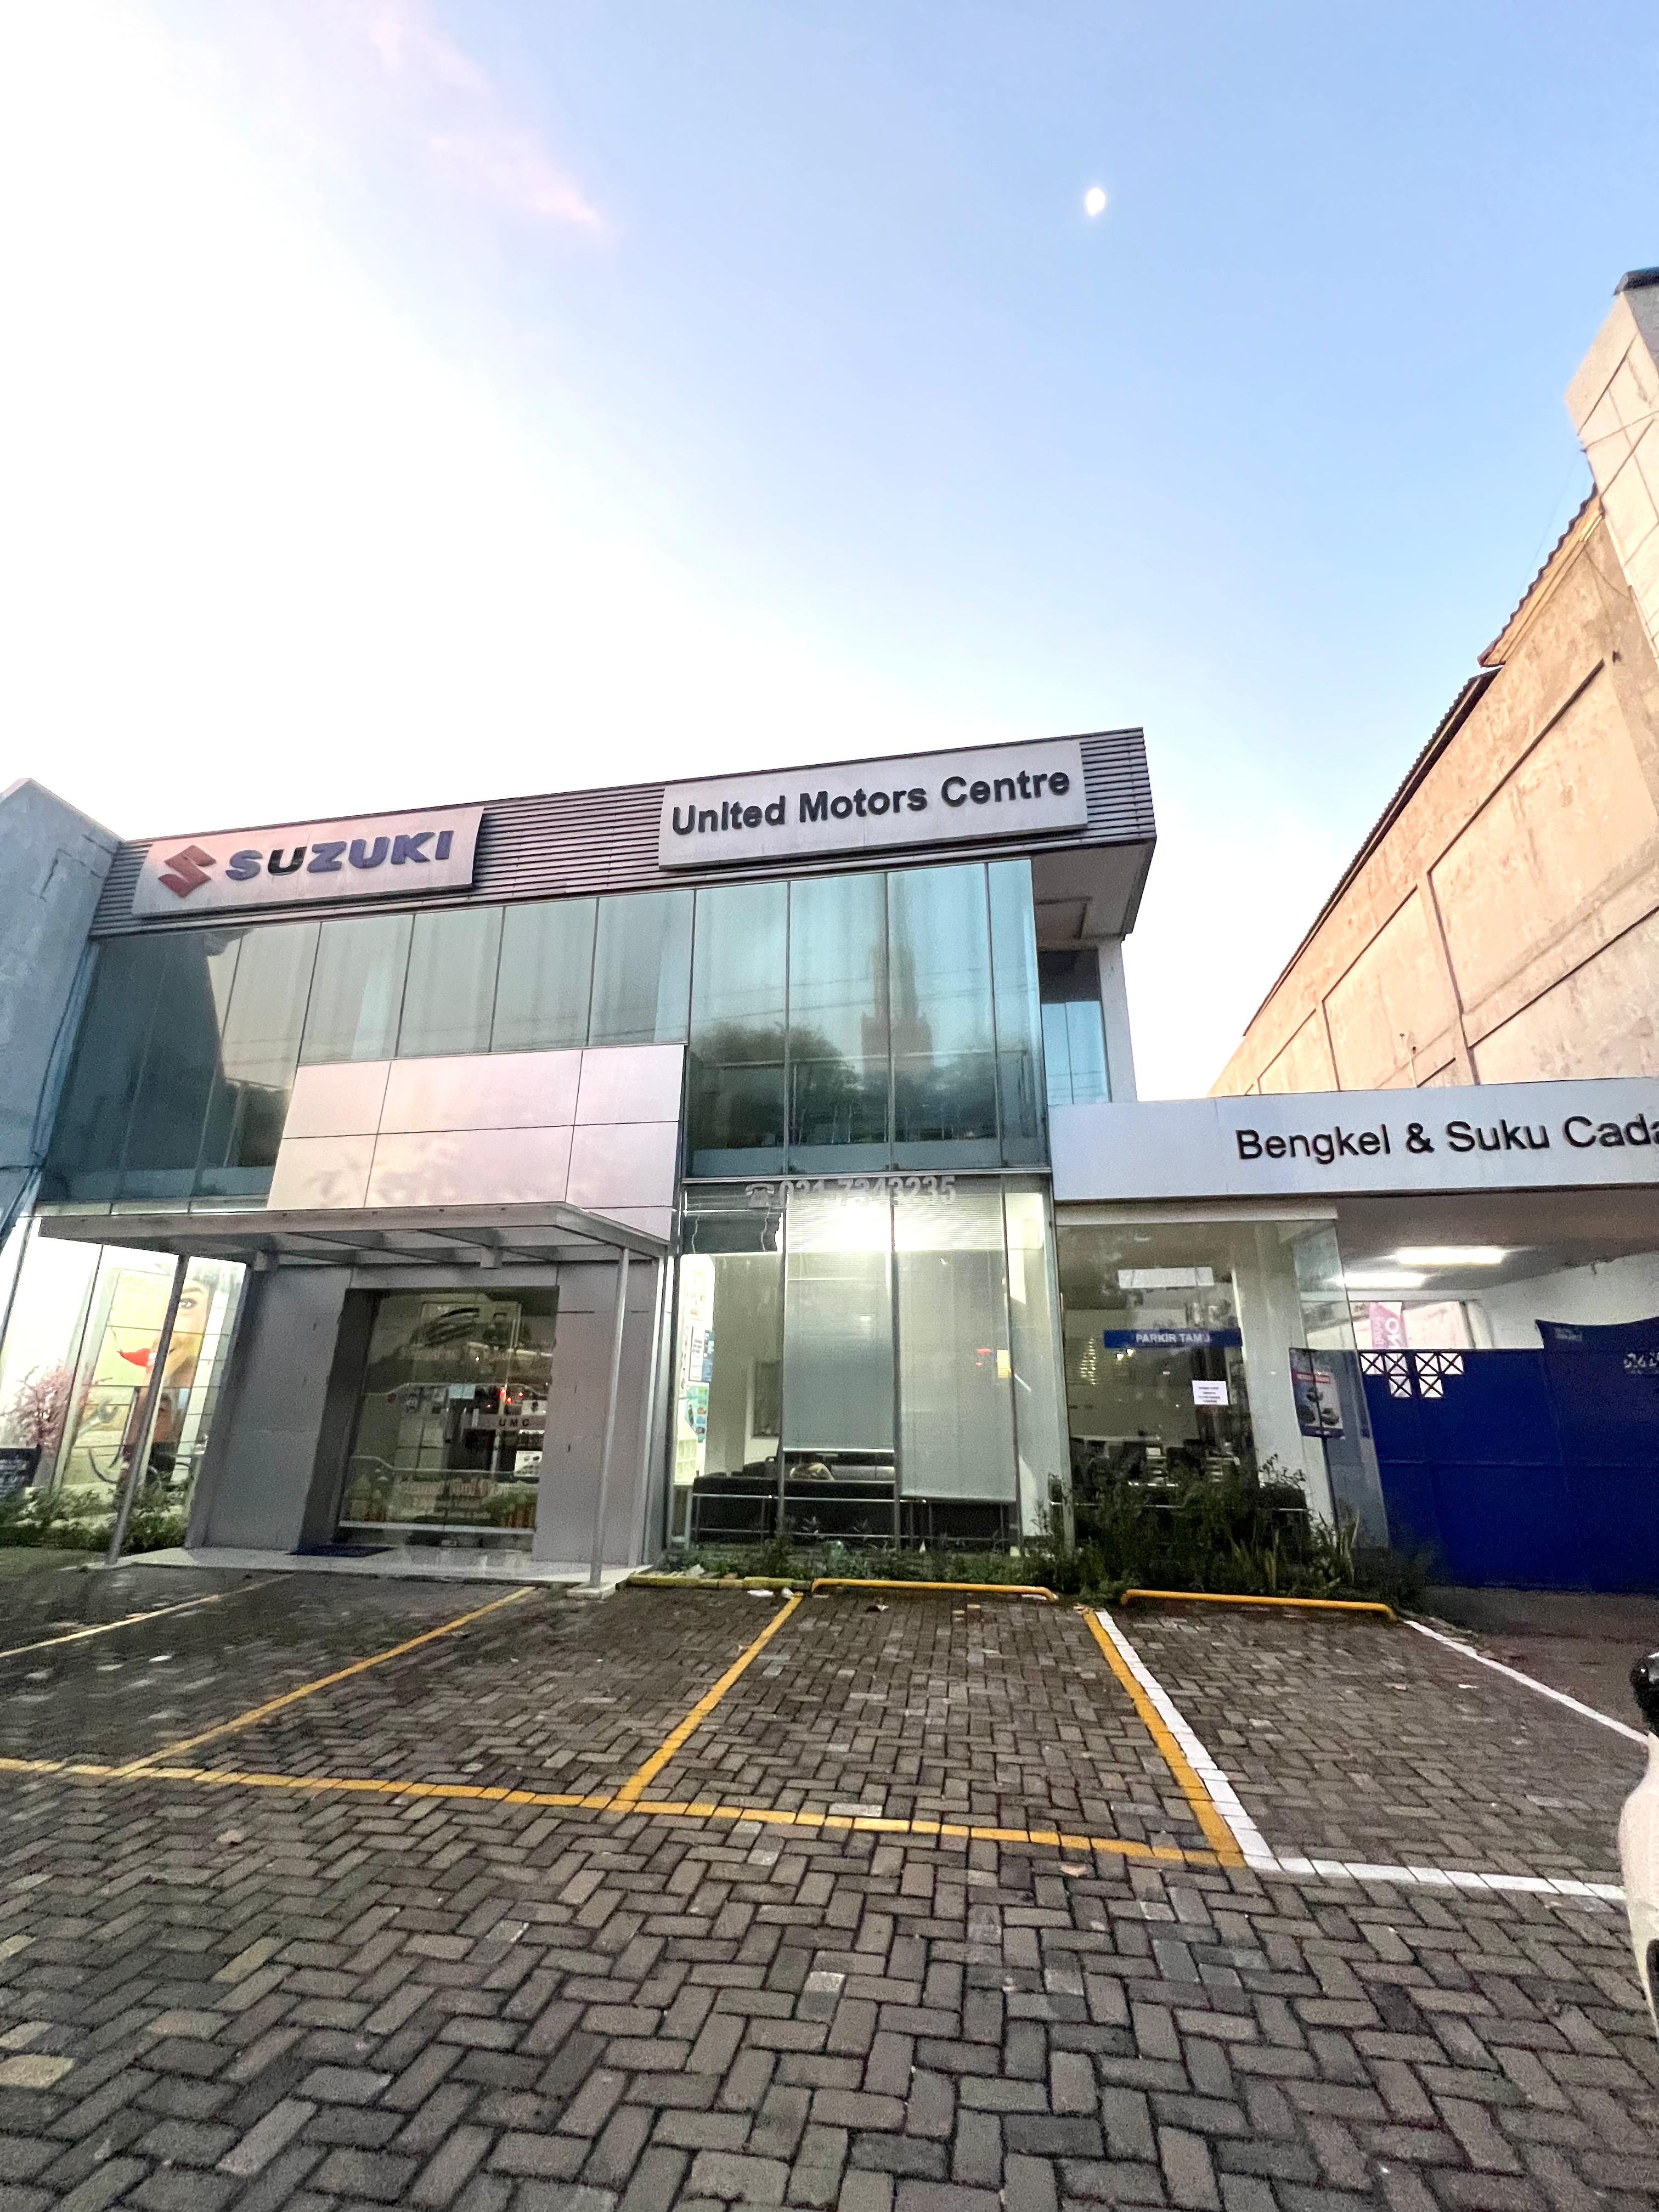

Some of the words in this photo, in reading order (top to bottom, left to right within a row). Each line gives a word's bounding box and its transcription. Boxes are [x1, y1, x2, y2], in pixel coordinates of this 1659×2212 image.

[799, 787, 927, 823] Motors
[941, 770, 1070, 808] Centre
[225, 830, 454, 881] SUZUKI
[1235, 1124, 1390, 1165] Bengkel
[1406, 1122, 1435, 1153] &
[1447, 1119, 1550, 1152] Suku
[1136, 1333, 1177, 1343] PARKIR
